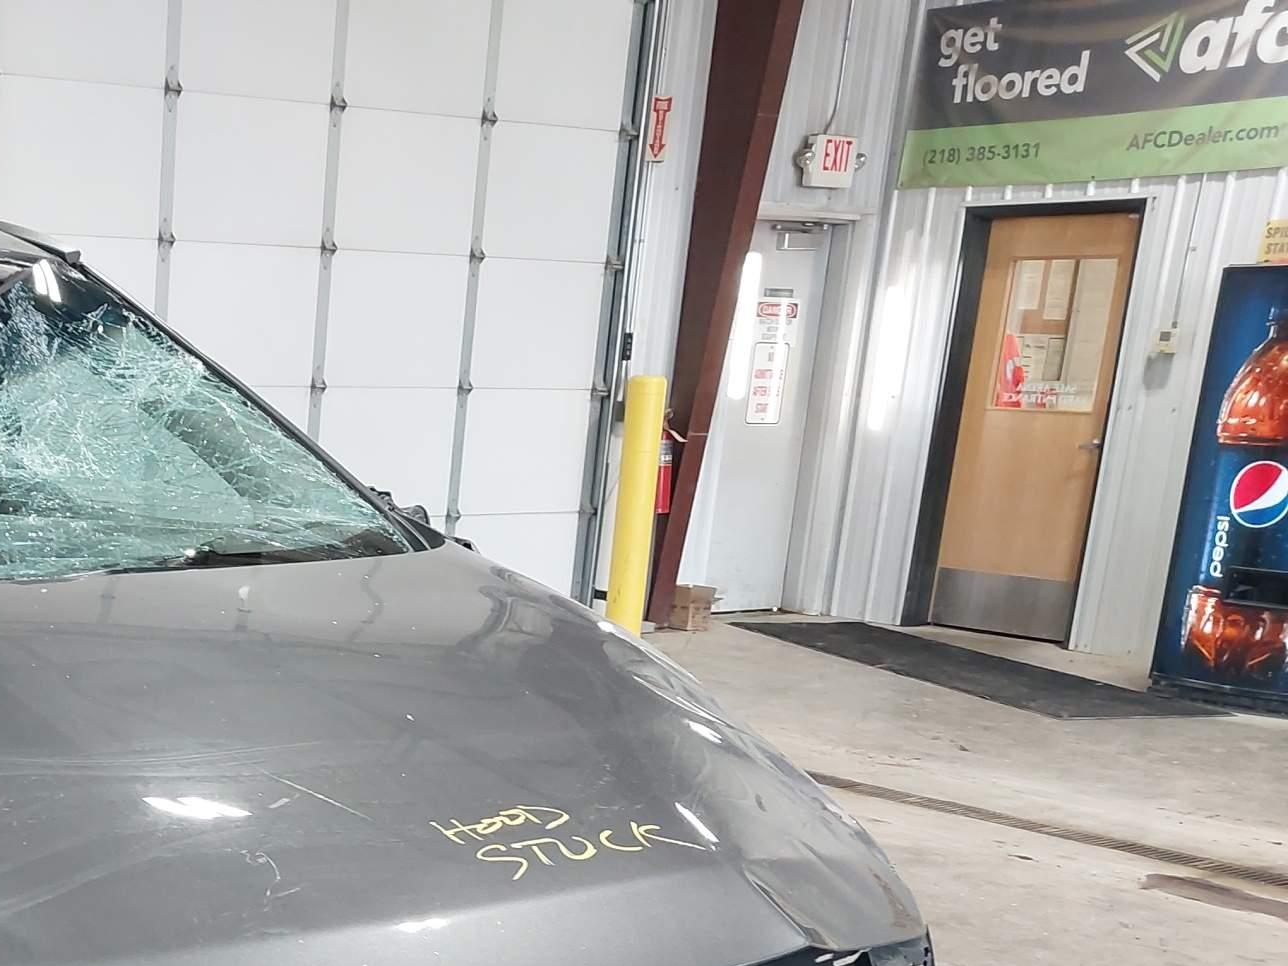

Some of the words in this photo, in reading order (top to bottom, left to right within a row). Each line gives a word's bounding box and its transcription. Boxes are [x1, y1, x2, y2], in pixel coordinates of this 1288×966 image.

[938, 17, 1003, 68] get
[952, 50, 1091, 104] floored
[823, 139, 853, 172] EXIT
[922, 148, 961, 166] (218)
[965, 143, 1041, 163] 385-3131
[1126, 124, 1280, 151] AFCDealer.com
[1210, 515, 1231, 578] pepsi
[476, 820, 706, 881] STUCK
